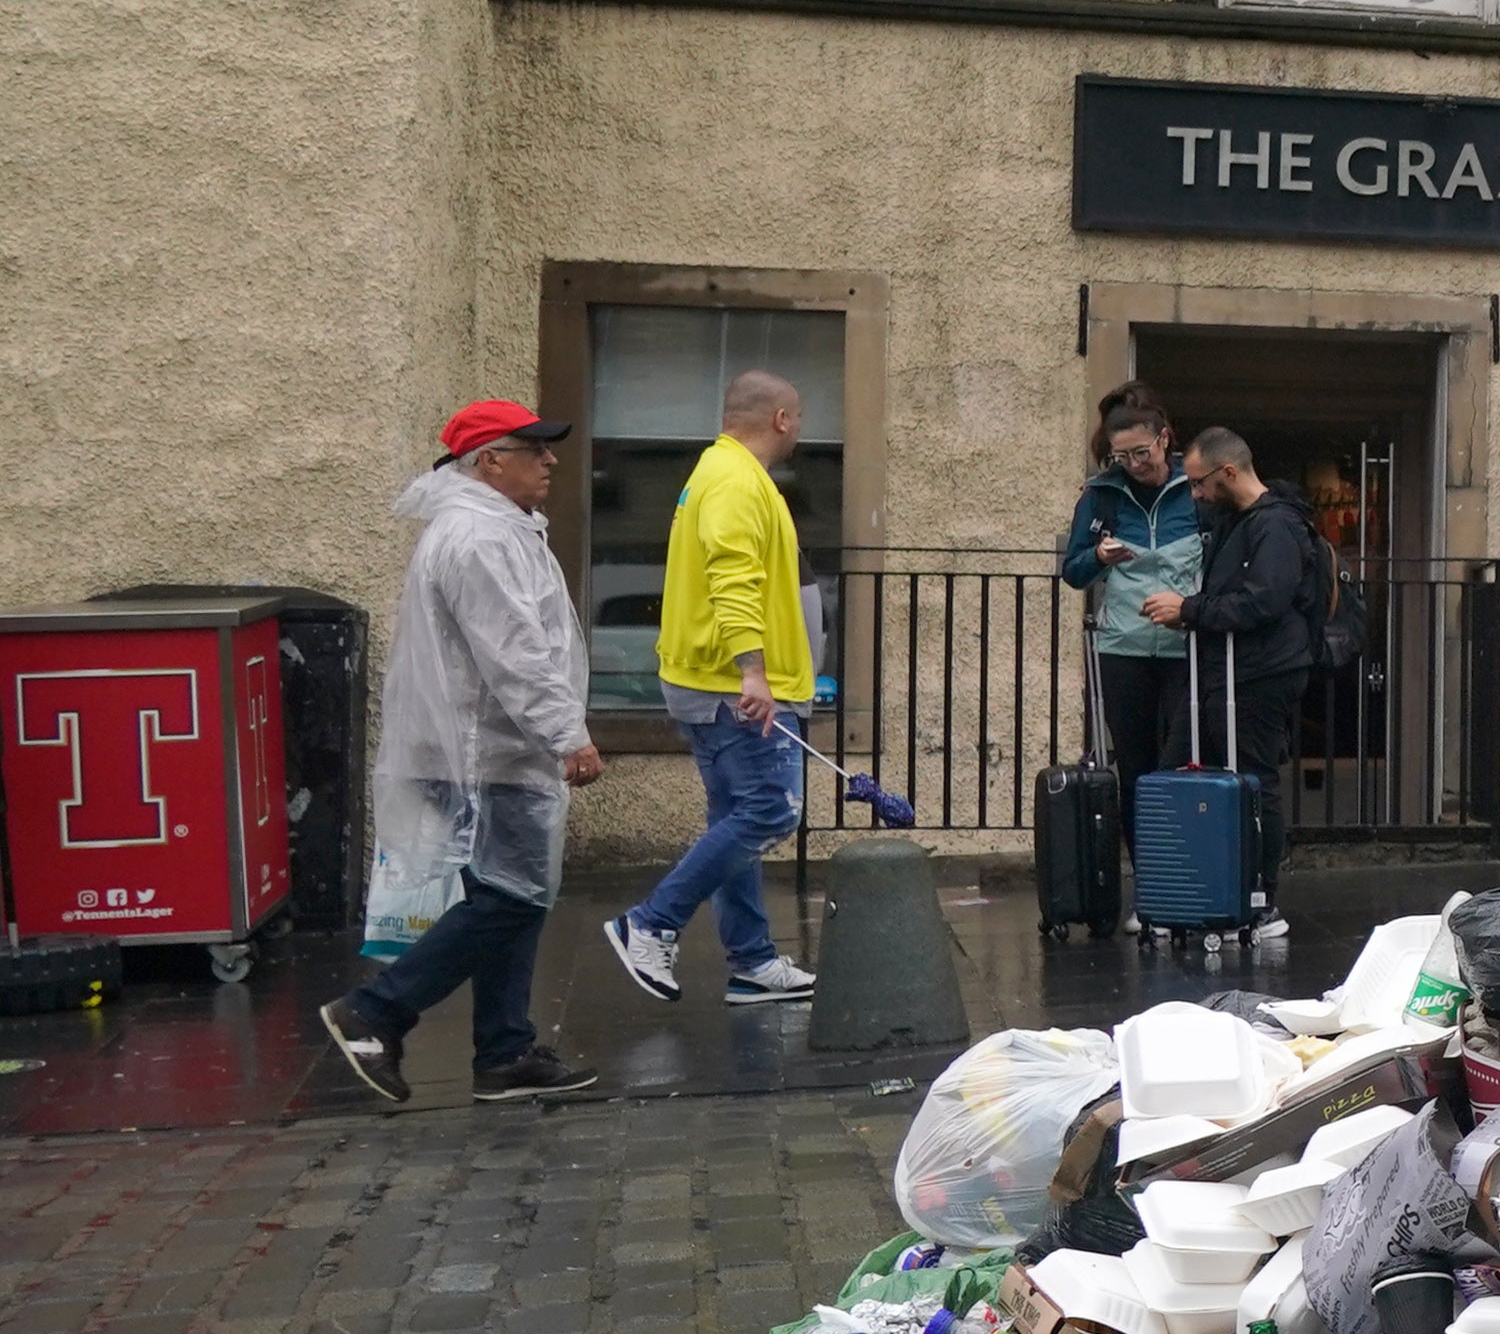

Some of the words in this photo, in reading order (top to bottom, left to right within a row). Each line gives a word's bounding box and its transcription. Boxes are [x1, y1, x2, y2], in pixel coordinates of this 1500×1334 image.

[1166, 126, 1313, 192] THE
[62, 906, 174, 924] @TennentsLager
[1411, 988, 1462, 1016] Sprite
[1322, 1083, 1378, 1111] pizza
[1426, 1198, 1458, 1220] WORLD
[1339, 1233, 1367, 1297] Freshly
[1363, 1150, 1401, 1239] Prepared
[1386, 1202, 1421, 1259] CHIPS
